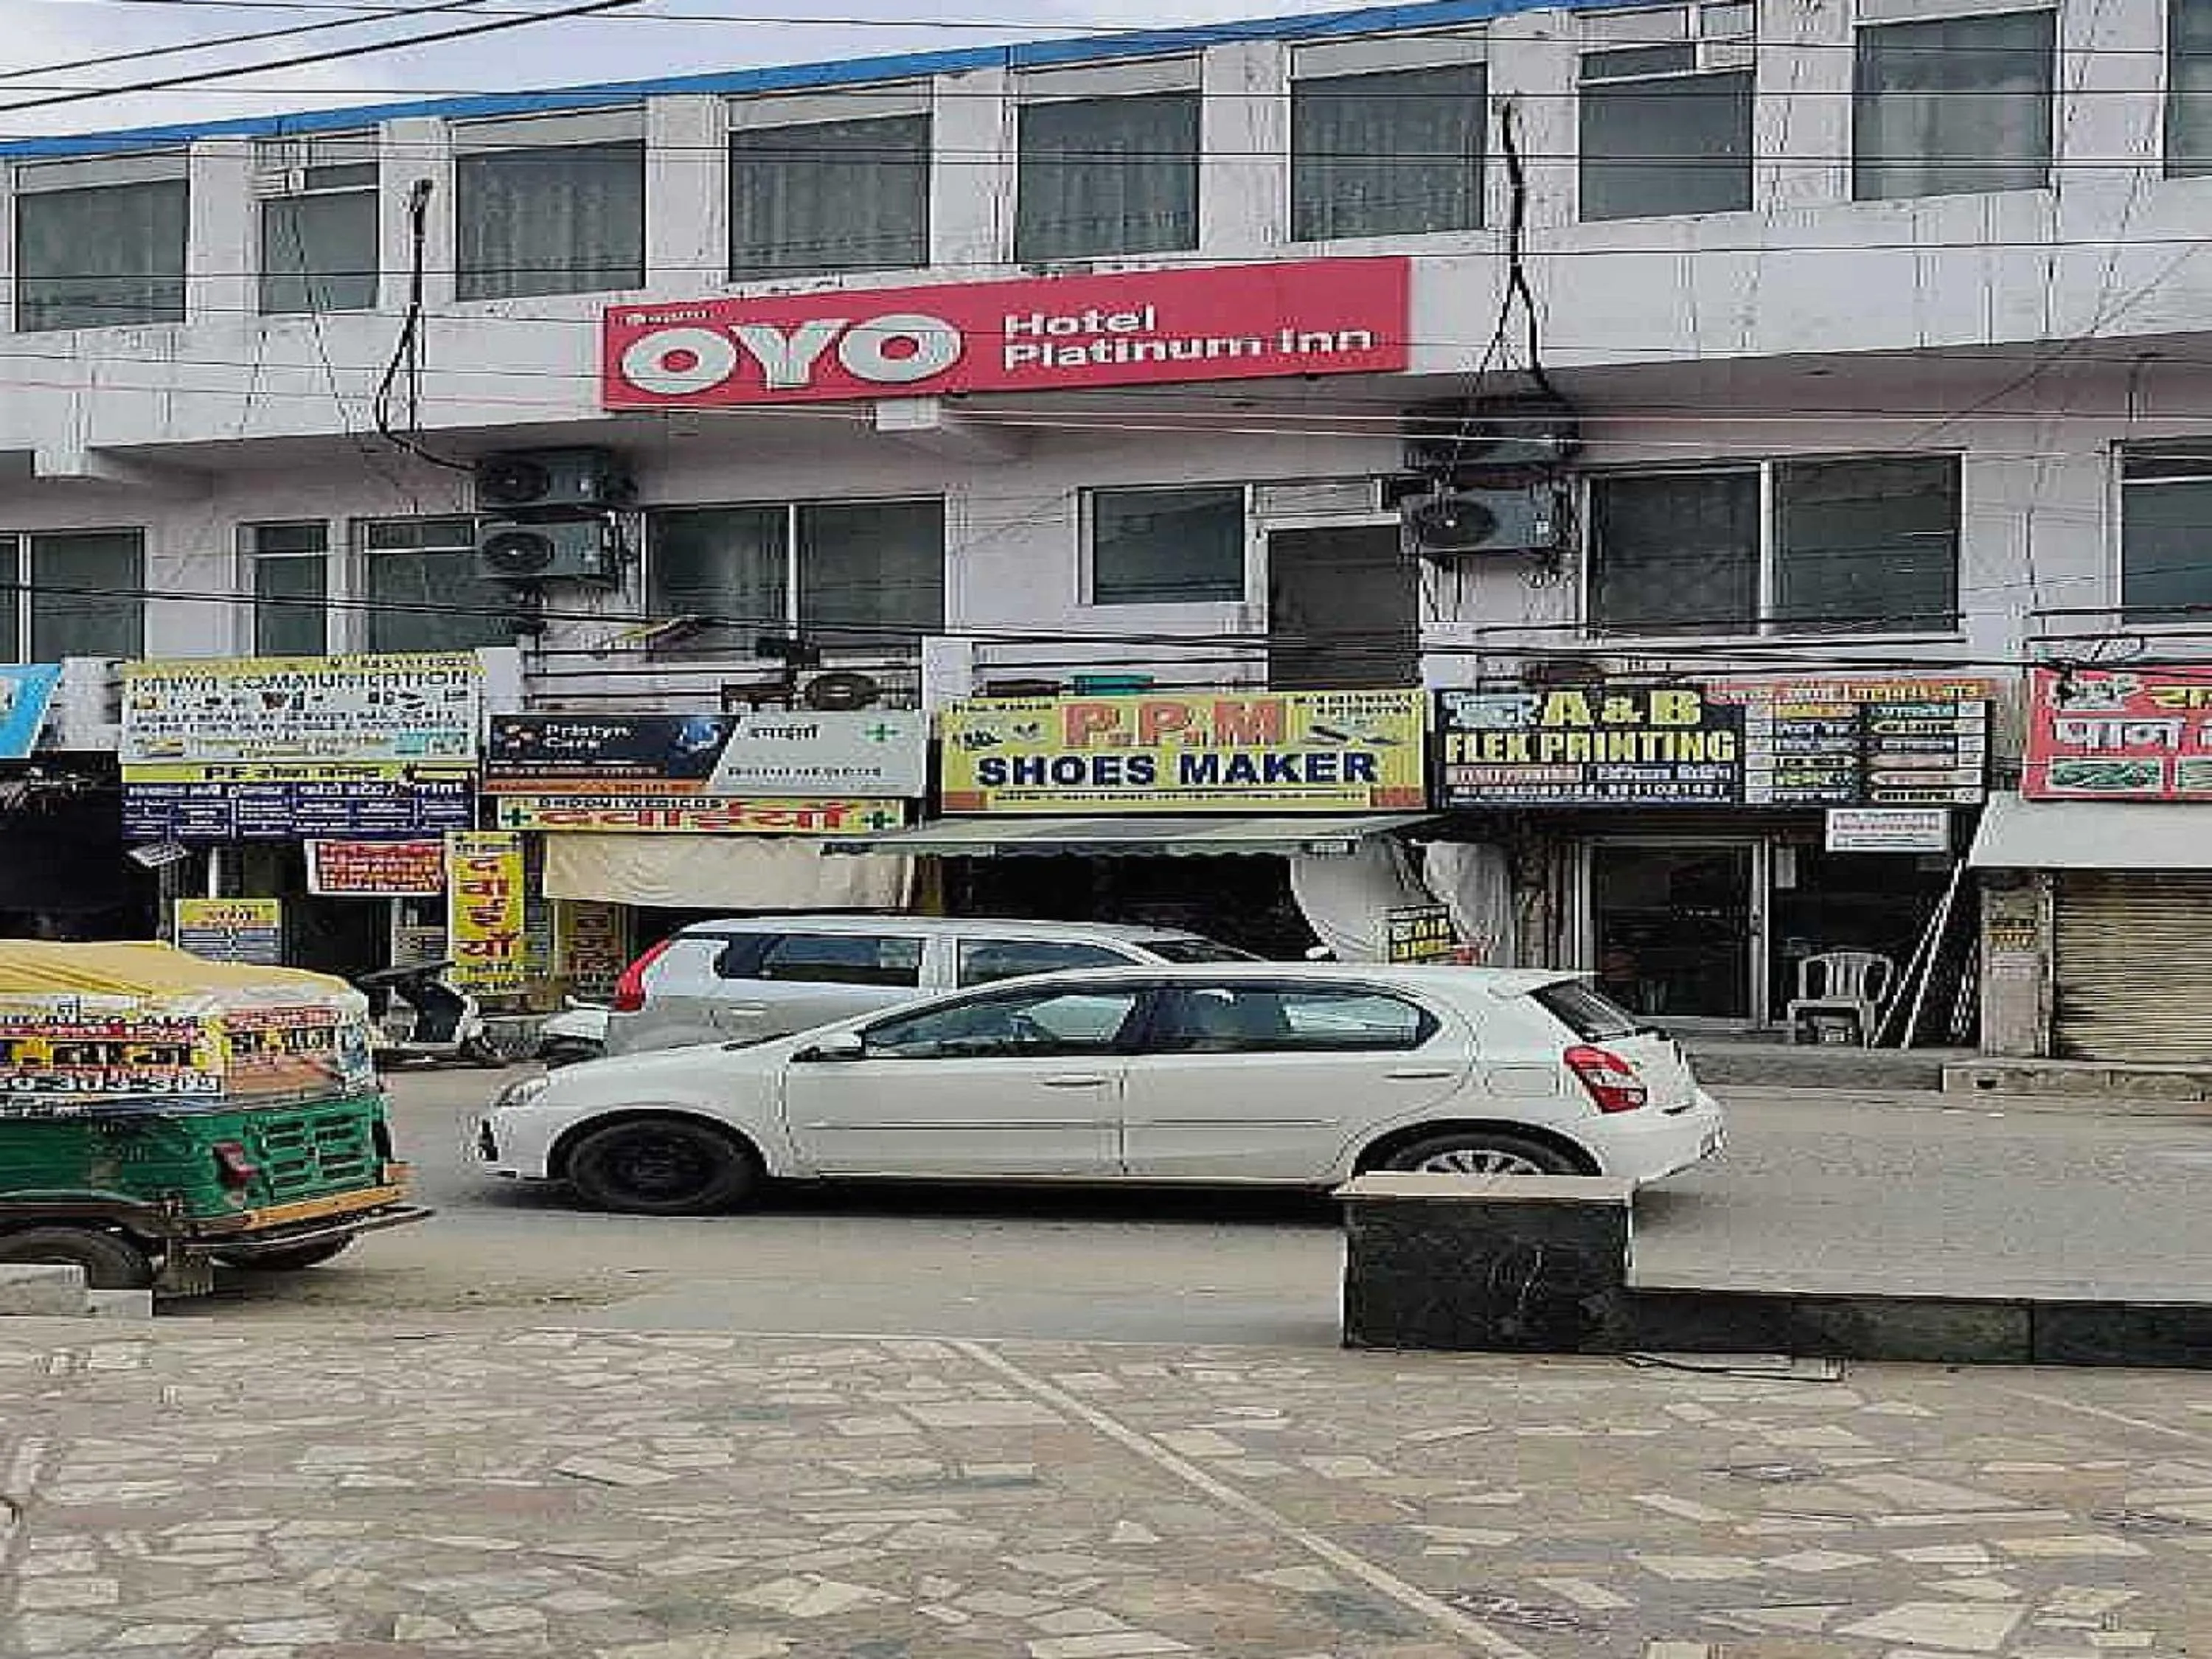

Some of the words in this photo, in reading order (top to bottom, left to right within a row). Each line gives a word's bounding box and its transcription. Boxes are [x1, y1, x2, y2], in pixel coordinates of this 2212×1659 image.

[1004, 305, 1156, 338] Hotel
[620, 315, 965, 395] OYO
[1004, 335, 1262, 370] Platinum
[1281, 327, 1372, 354] Inn
[1543, 691, 1592, 726] A
[1601, 696, 1644, 724] &
[1650, 690, 1702, 726] B
[544, 723, 631, 740] Pristyn
[1540, 730, 1736, 762] PRINTING
[977, 754, 1155, 786] SHOES
[1179, 752, 1377, 784] MAKER
